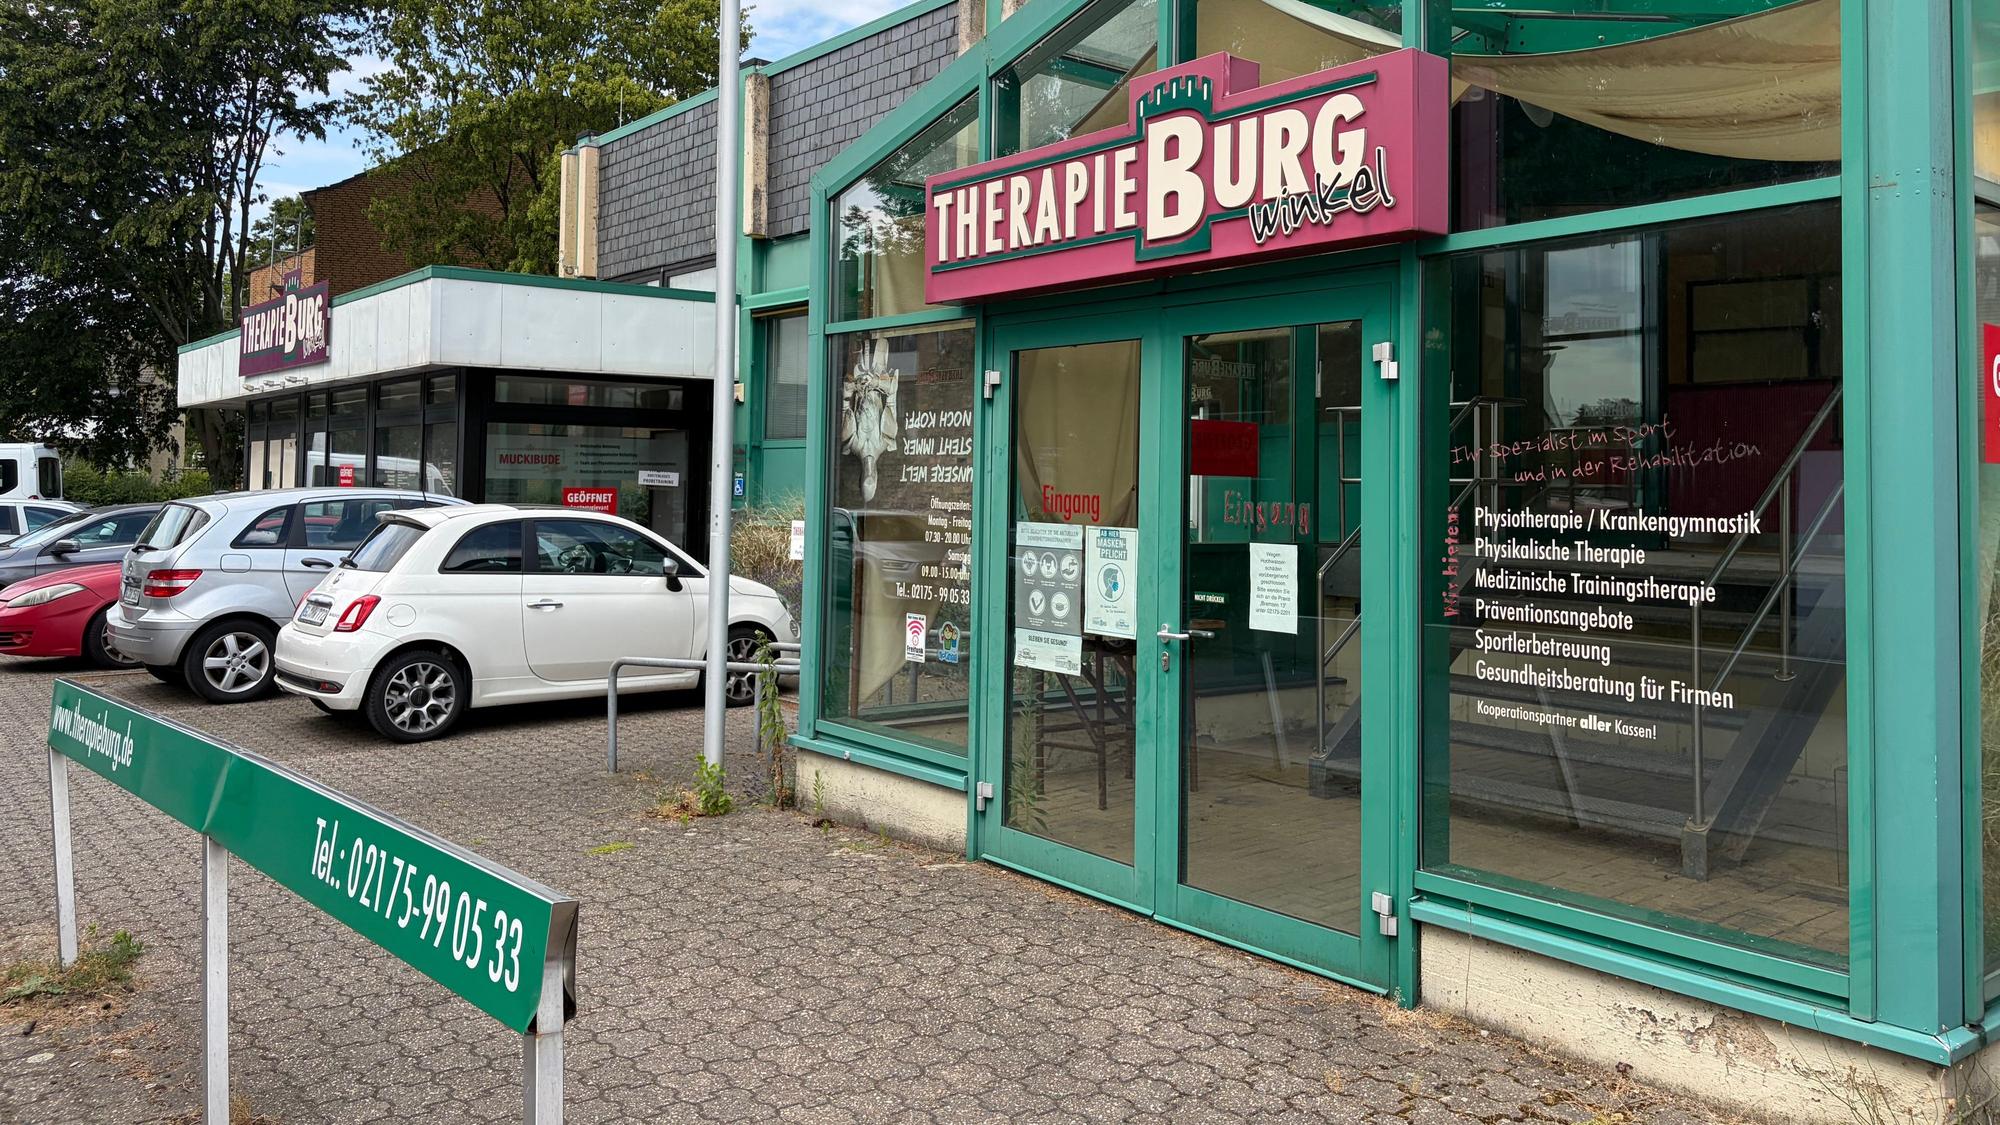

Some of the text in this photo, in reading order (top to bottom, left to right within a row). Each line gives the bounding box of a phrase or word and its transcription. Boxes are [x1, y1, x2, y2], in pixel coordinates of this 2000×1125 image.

[905, 410, 972, 430] NOCH KOPF!
[903, 437, 972, 455] STEHT IMMER
[1451, 445, 1482, 466] Ihr
[1587, 430, 1608, 446] im
[499, 454, 561, 465] MUCKIBUDE
[1514, 438, 1761, 483] und in der Rehabilitation
[900, 464, 974, 483] UNSERE WELT
[567, 491, 613, 502] GEÖFFNET
[930, 495, 972, 512] Öffnungszeiten:
[1042, 485, 1101, 522] Eingang
[928, 514, 948, 528] Montag
[953, 515, 971, 530] Freitag
[1475, 507, 1583, 534] Physiotherapie
[1600, 509, 1761, 537] Krankengymnastik
[925, 531, 940, 542] 07.30
[944, 532, 961, 544] 20.00
[961, 533, 971, 545] Uhr
[1097, 538, 1126, 548] MASKEN-
[948, 549, 971, 565] Samstag
[1101, 549, 1127, 560] PFLICHT
[1475, 537, 1645, 568] Physikalische Therapie
[921, 565, 938, 578] 09.00
[942, 567, 957, 579] 15.00
[896, 582, 910, 598] Tel.:
[911, 584, 932, 600] 02175
[939, 587, 948, 602] 99
[950, 588, 959, 603] 05
[961, 590, 970, 604] 33
[1475, 568, 1716, 605] Medizinische Trainingstherapie
[1475, 598, 1633, 631] Präventionsangebote
[1475, 629, 1611, 666] Sportlerbetreuung
[1476, 660, 1734, 709] Gesundheitsberatung für Firmen
[1477, 700, 1657, 740] Kooperationspartner aller Kassen!
[53, 698, 134, 771] www.therapieburg.de
[311, 817, 345, 889] Tel.:
[452, 891, 487, 969] 05
[488, 910, 523, 992] 33
